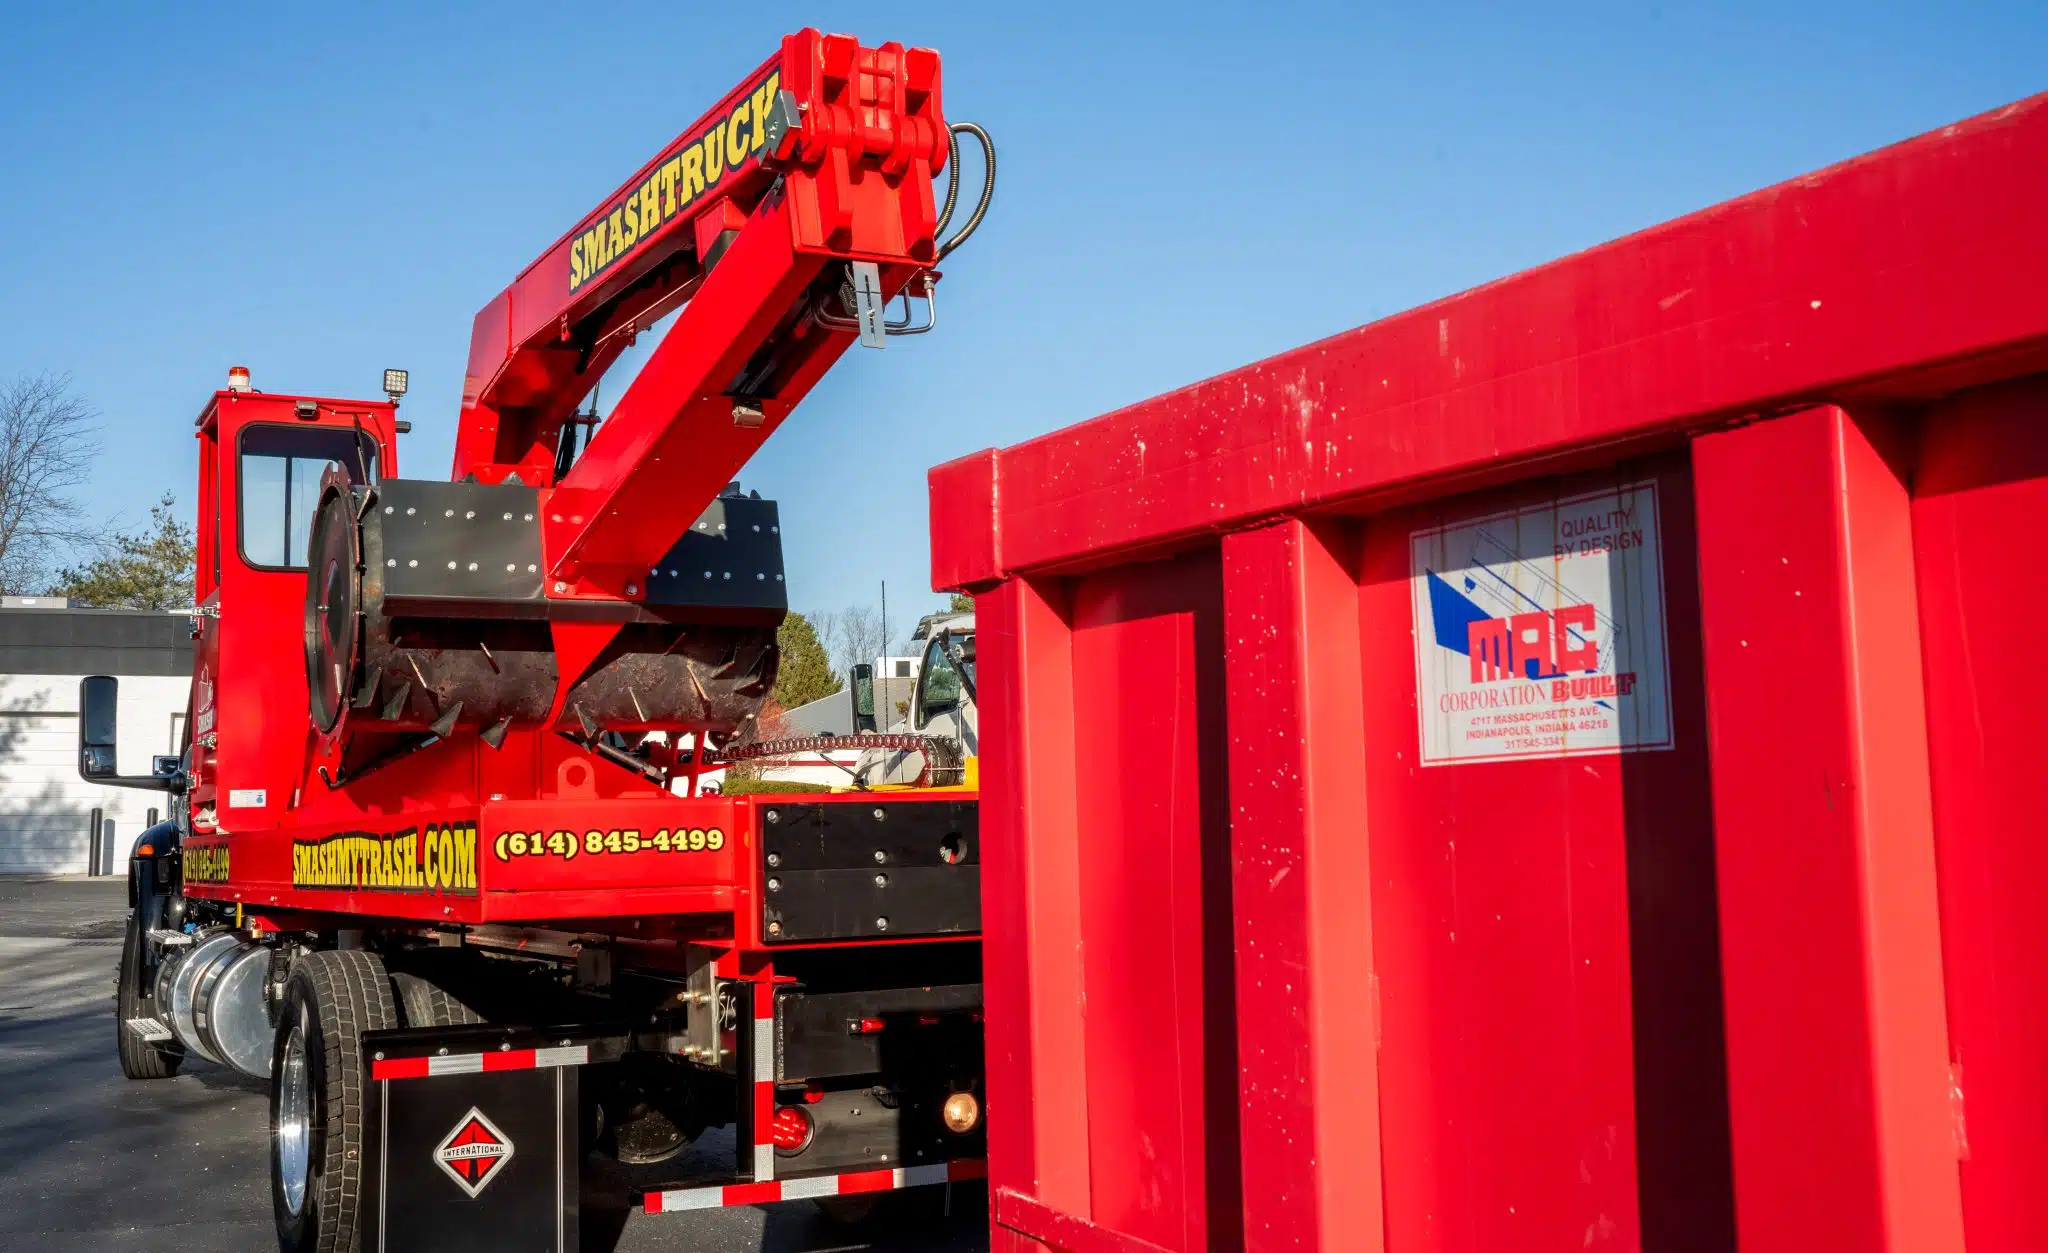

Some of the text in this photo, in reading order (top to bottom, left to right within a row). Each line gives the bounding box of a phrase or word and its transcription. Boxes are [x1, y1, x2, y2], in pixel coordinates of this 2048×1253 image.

[569, 69, 780, 292] SMASHTRUCK
[1561, 509, 1632, 538] QUALITY
[1553, 529, 1643, 562] BY DESIGN
[1467, 603, 1598, 684] MAC
[1439, 672, 1636, 713] CORPORATION BUILT
[1466, 725, 1533, 741] INDIANAPOLIS,
[1535, 721, 1576, 734] INDIANA
[1470, 715, 1492, 726] 4717
[1493, 708, 1576, 725] MASSACHUSETTS
[292, 825, 477, 890] SMASHMYTRASH.COM
[494, 828, 724, 861] (614) 845-4499
[443, 1145, 504, 1158] INTERNATIONAL
